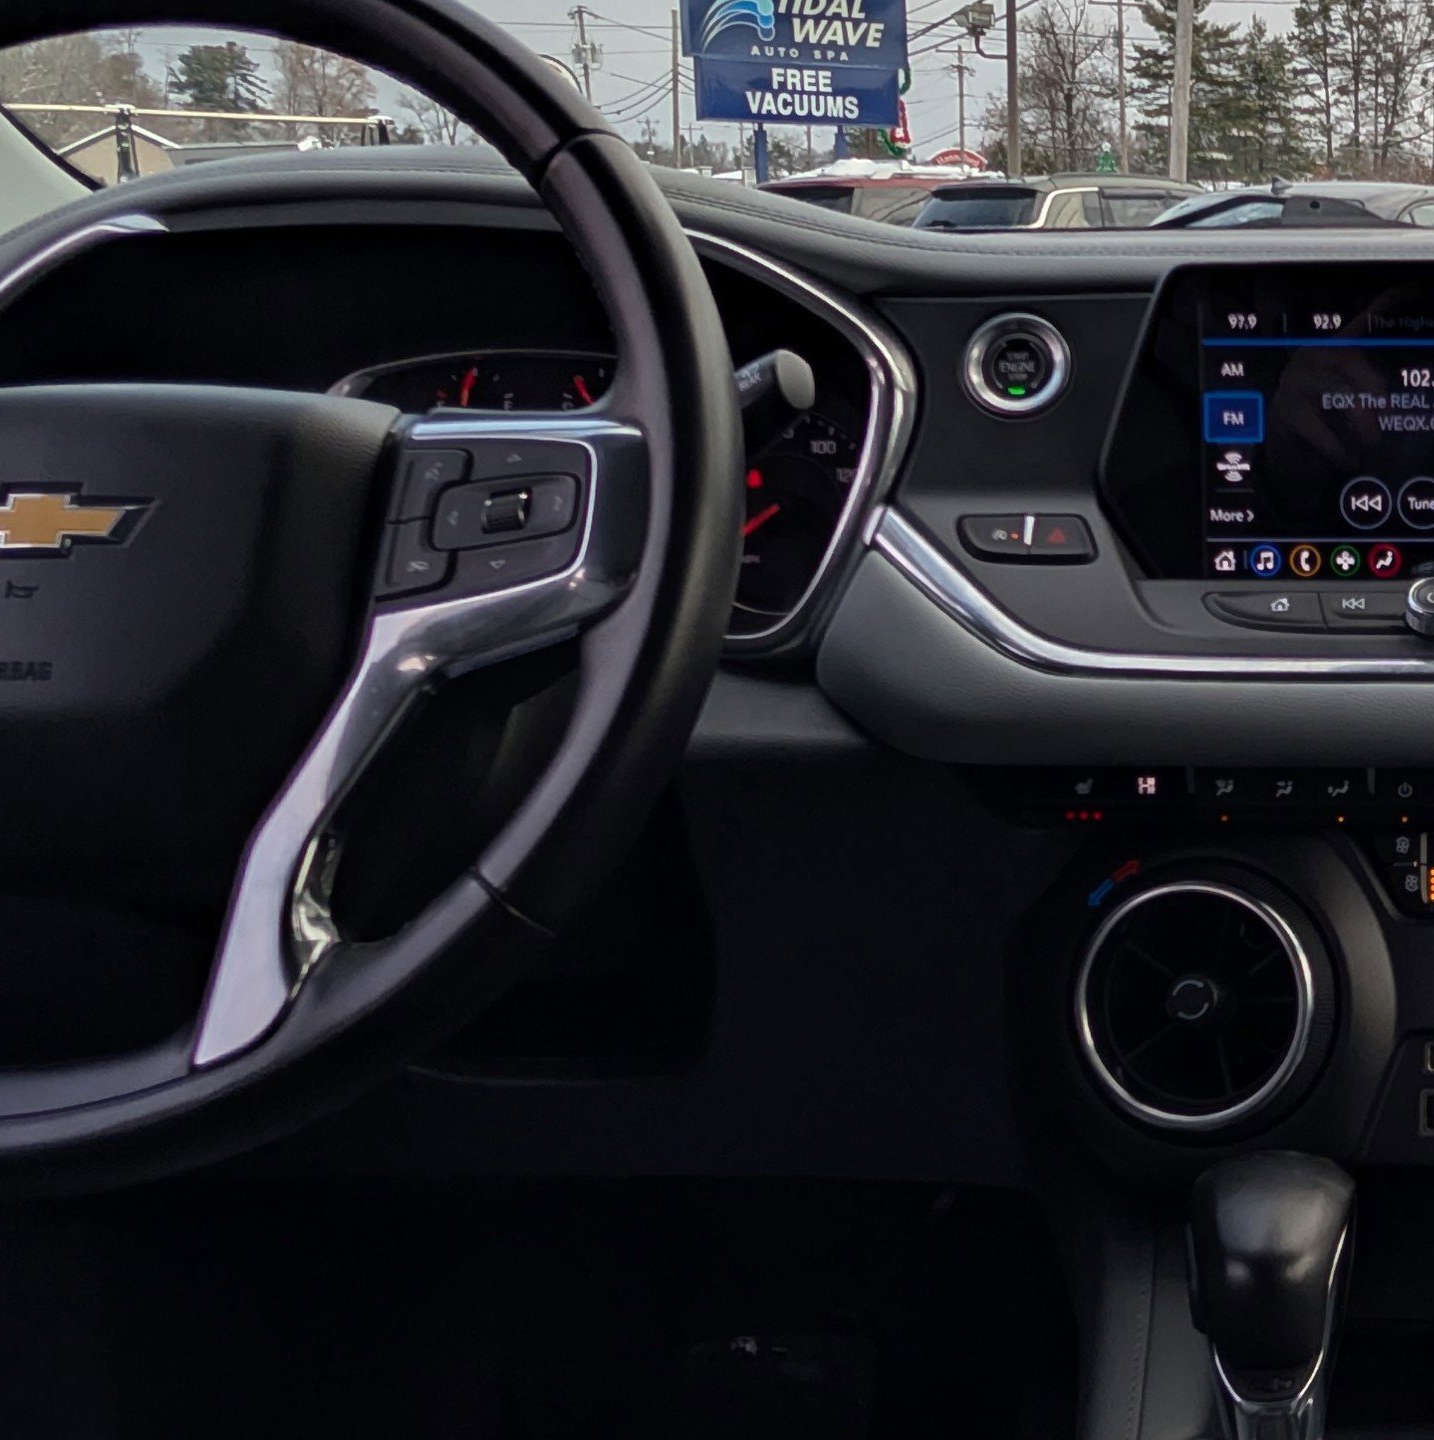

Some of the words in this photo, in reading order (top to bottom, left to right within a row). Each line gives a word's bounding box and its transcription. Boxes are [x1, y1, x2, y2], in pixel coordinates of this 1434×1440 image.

[791, 17, 885, 48] WAVE
[750, 45, 799, 59] AUTO
[814, 48, 849, 61] SPA
[771, 67, 833, 93] FREE
[745, 90, 860, 119] VACUUMS
[1227, 313, 1258, 331] 97.9
[1312, 313, 1342, 331] 92.9
[1221, 362, 1245, 377] AM
[1321, 393, 1356, 411] EQX
[1359, 393, 1387, 410] The
[1390, 393, 1430, 410] REAL
[1222, 411, 1245, 427] FM
[809, 439, 837, 455] 100
[1209, 508, 1245, 523] More
